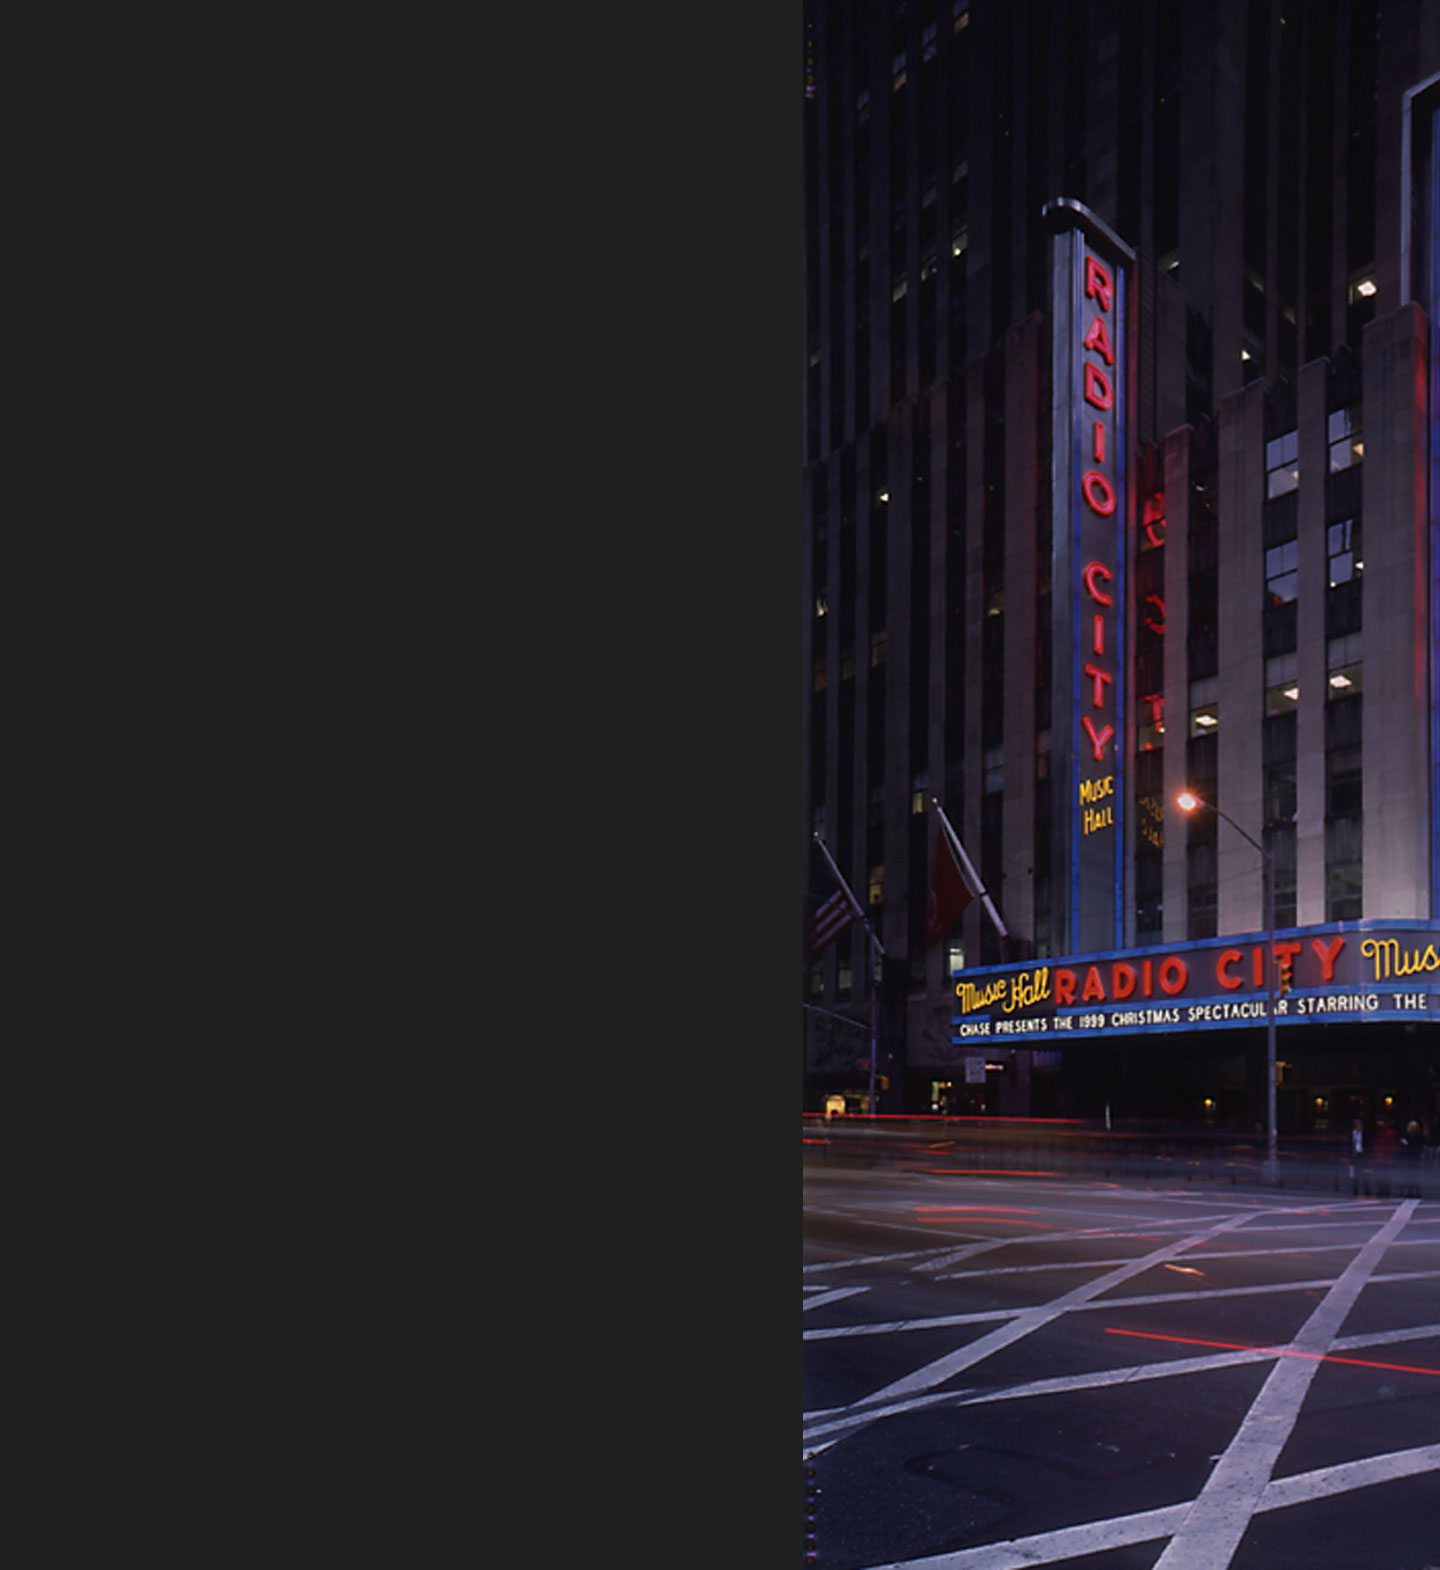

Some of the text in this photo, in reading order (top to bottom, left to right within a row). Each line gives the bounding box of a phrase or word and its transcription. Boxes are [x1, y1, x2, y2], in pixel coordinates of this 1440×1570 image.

[1082, 255, 1116, 761] RADIO CITY
[1079, 776, 1114, 806] MUSIC
[1083, 807, 1114, 835] HALL
[956, 936, 1345, 1014] Music Hall RADIO CITY
[959, 1022, 991, 1036] CHASE
[995, 1017, 1048, 1033] PRESENTS
[1053, 1015, 1073, 1030] THE
[1079, 1013, 1105, 1028] 1999
[1111, 1008, 1180, 1027] CHRISTMAS
[1297, 993, 1379, 1015] STARRING
[1392, 993, 1428, 1010] THE
